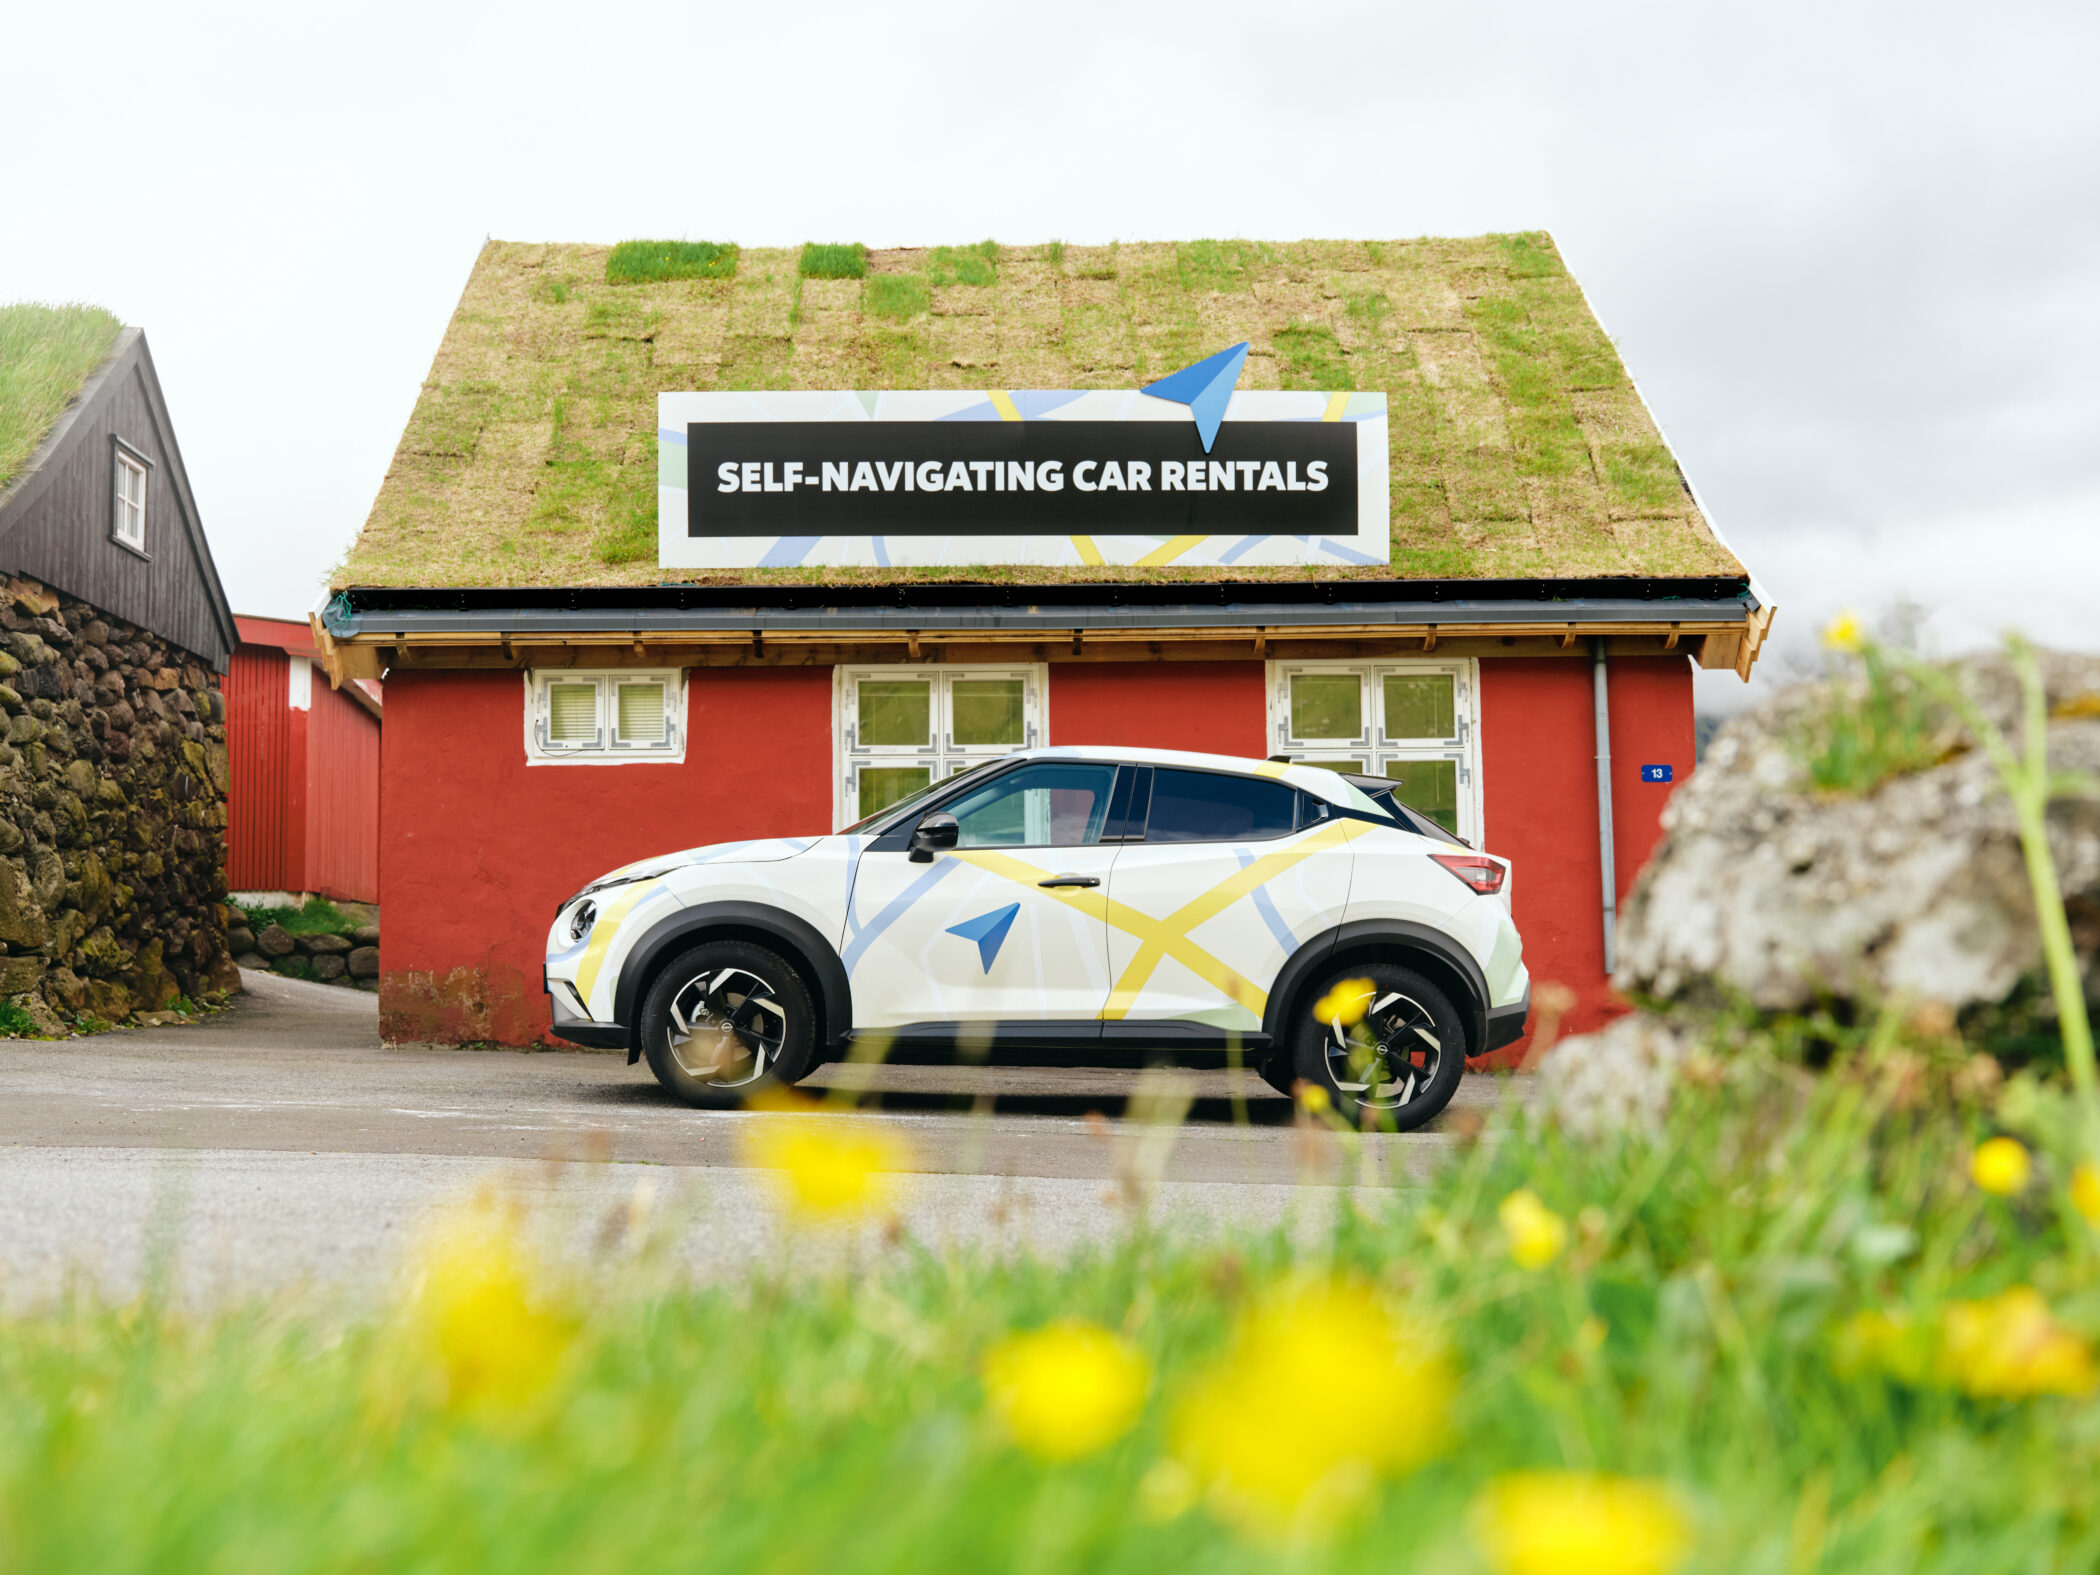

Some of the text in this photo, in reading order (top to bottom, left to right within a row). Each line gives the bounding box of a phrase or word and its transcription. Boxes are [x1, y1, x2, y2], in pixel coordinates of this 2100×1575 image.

[717, 460, 1329, 492] SELF-NAVIGATING CAR RENTALS
[1651, 768, 1663, 779] 13
